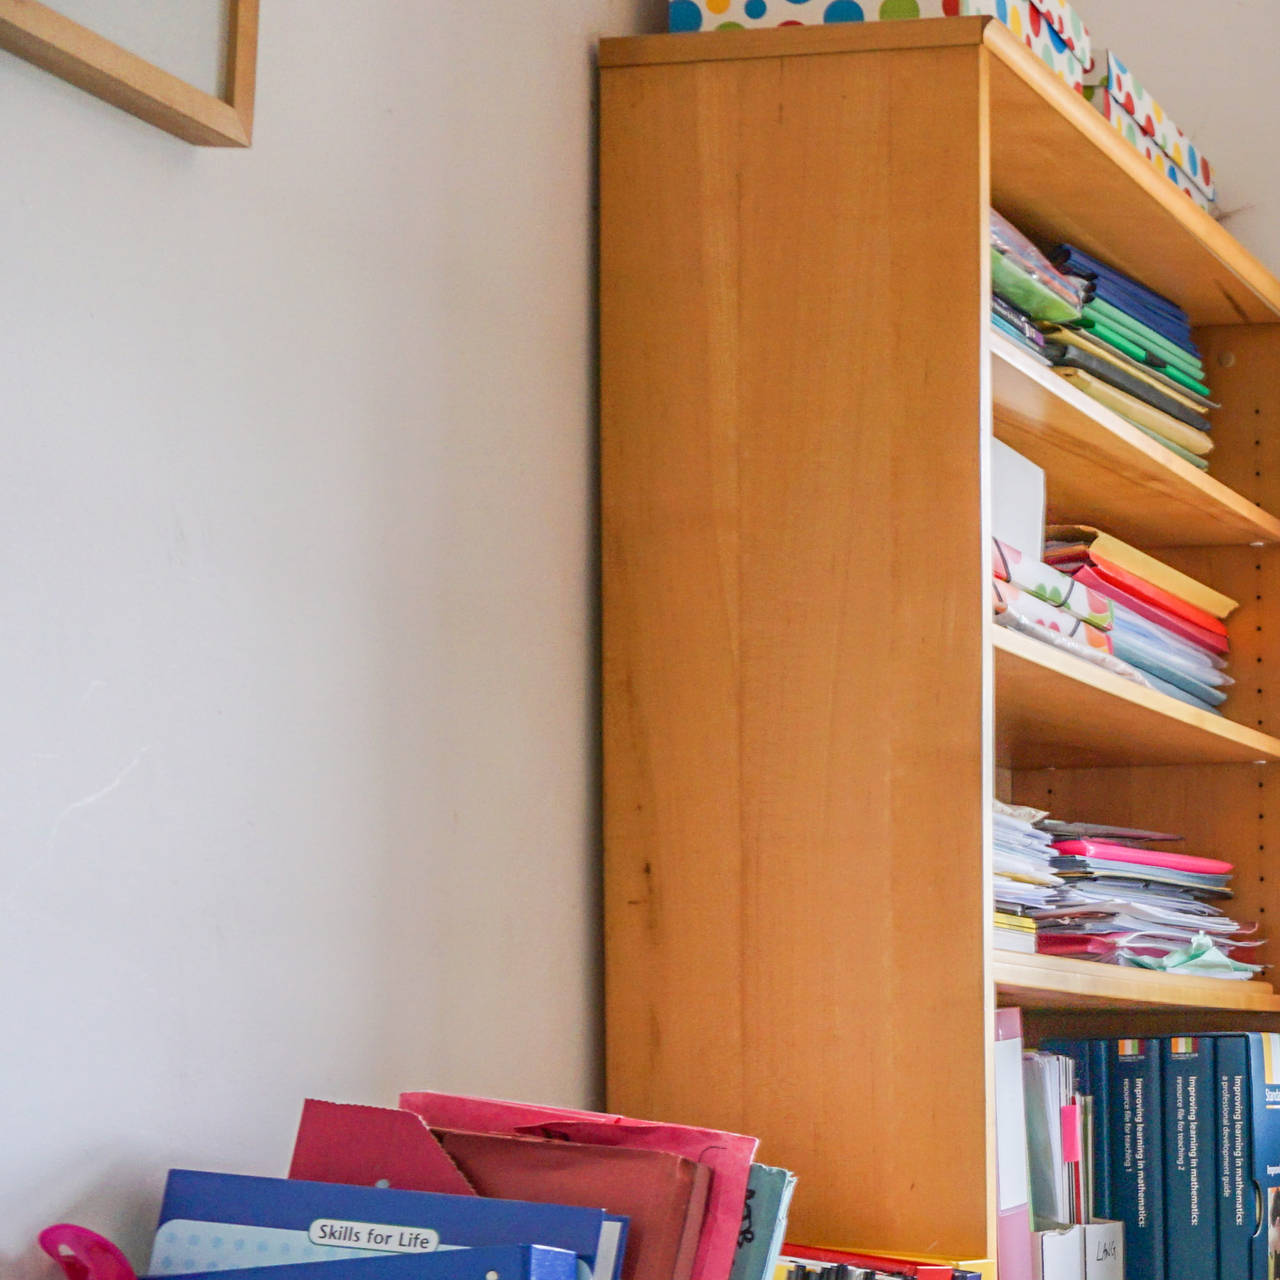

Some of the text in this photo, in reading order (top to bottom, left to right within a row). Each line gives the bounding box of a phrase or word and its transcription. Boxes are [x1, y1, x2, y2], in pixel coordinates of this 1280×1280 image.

[1221, 1081, 1231, 1126] professional
[1124, 1123, 1132, 1134] for
[1177, 1121, 1185, 1131] for
[1123, 1134, 1132, 1167] teaching
[1134, 1078, 1147, 1228] Improving learning in mathematics:
[1176, 1132, 1185, 1165] teaching
[1187, 1076, 1199, 1226] Improving learning in mathematics:
[1222, 1126, 1231, 1175] development
[1233, 1075, 1245, 1225] Improving learning in mathematics:
[1221, 1176, 1231, 1198] guide
[318, 1225, 430, 1249] Skills for Life
